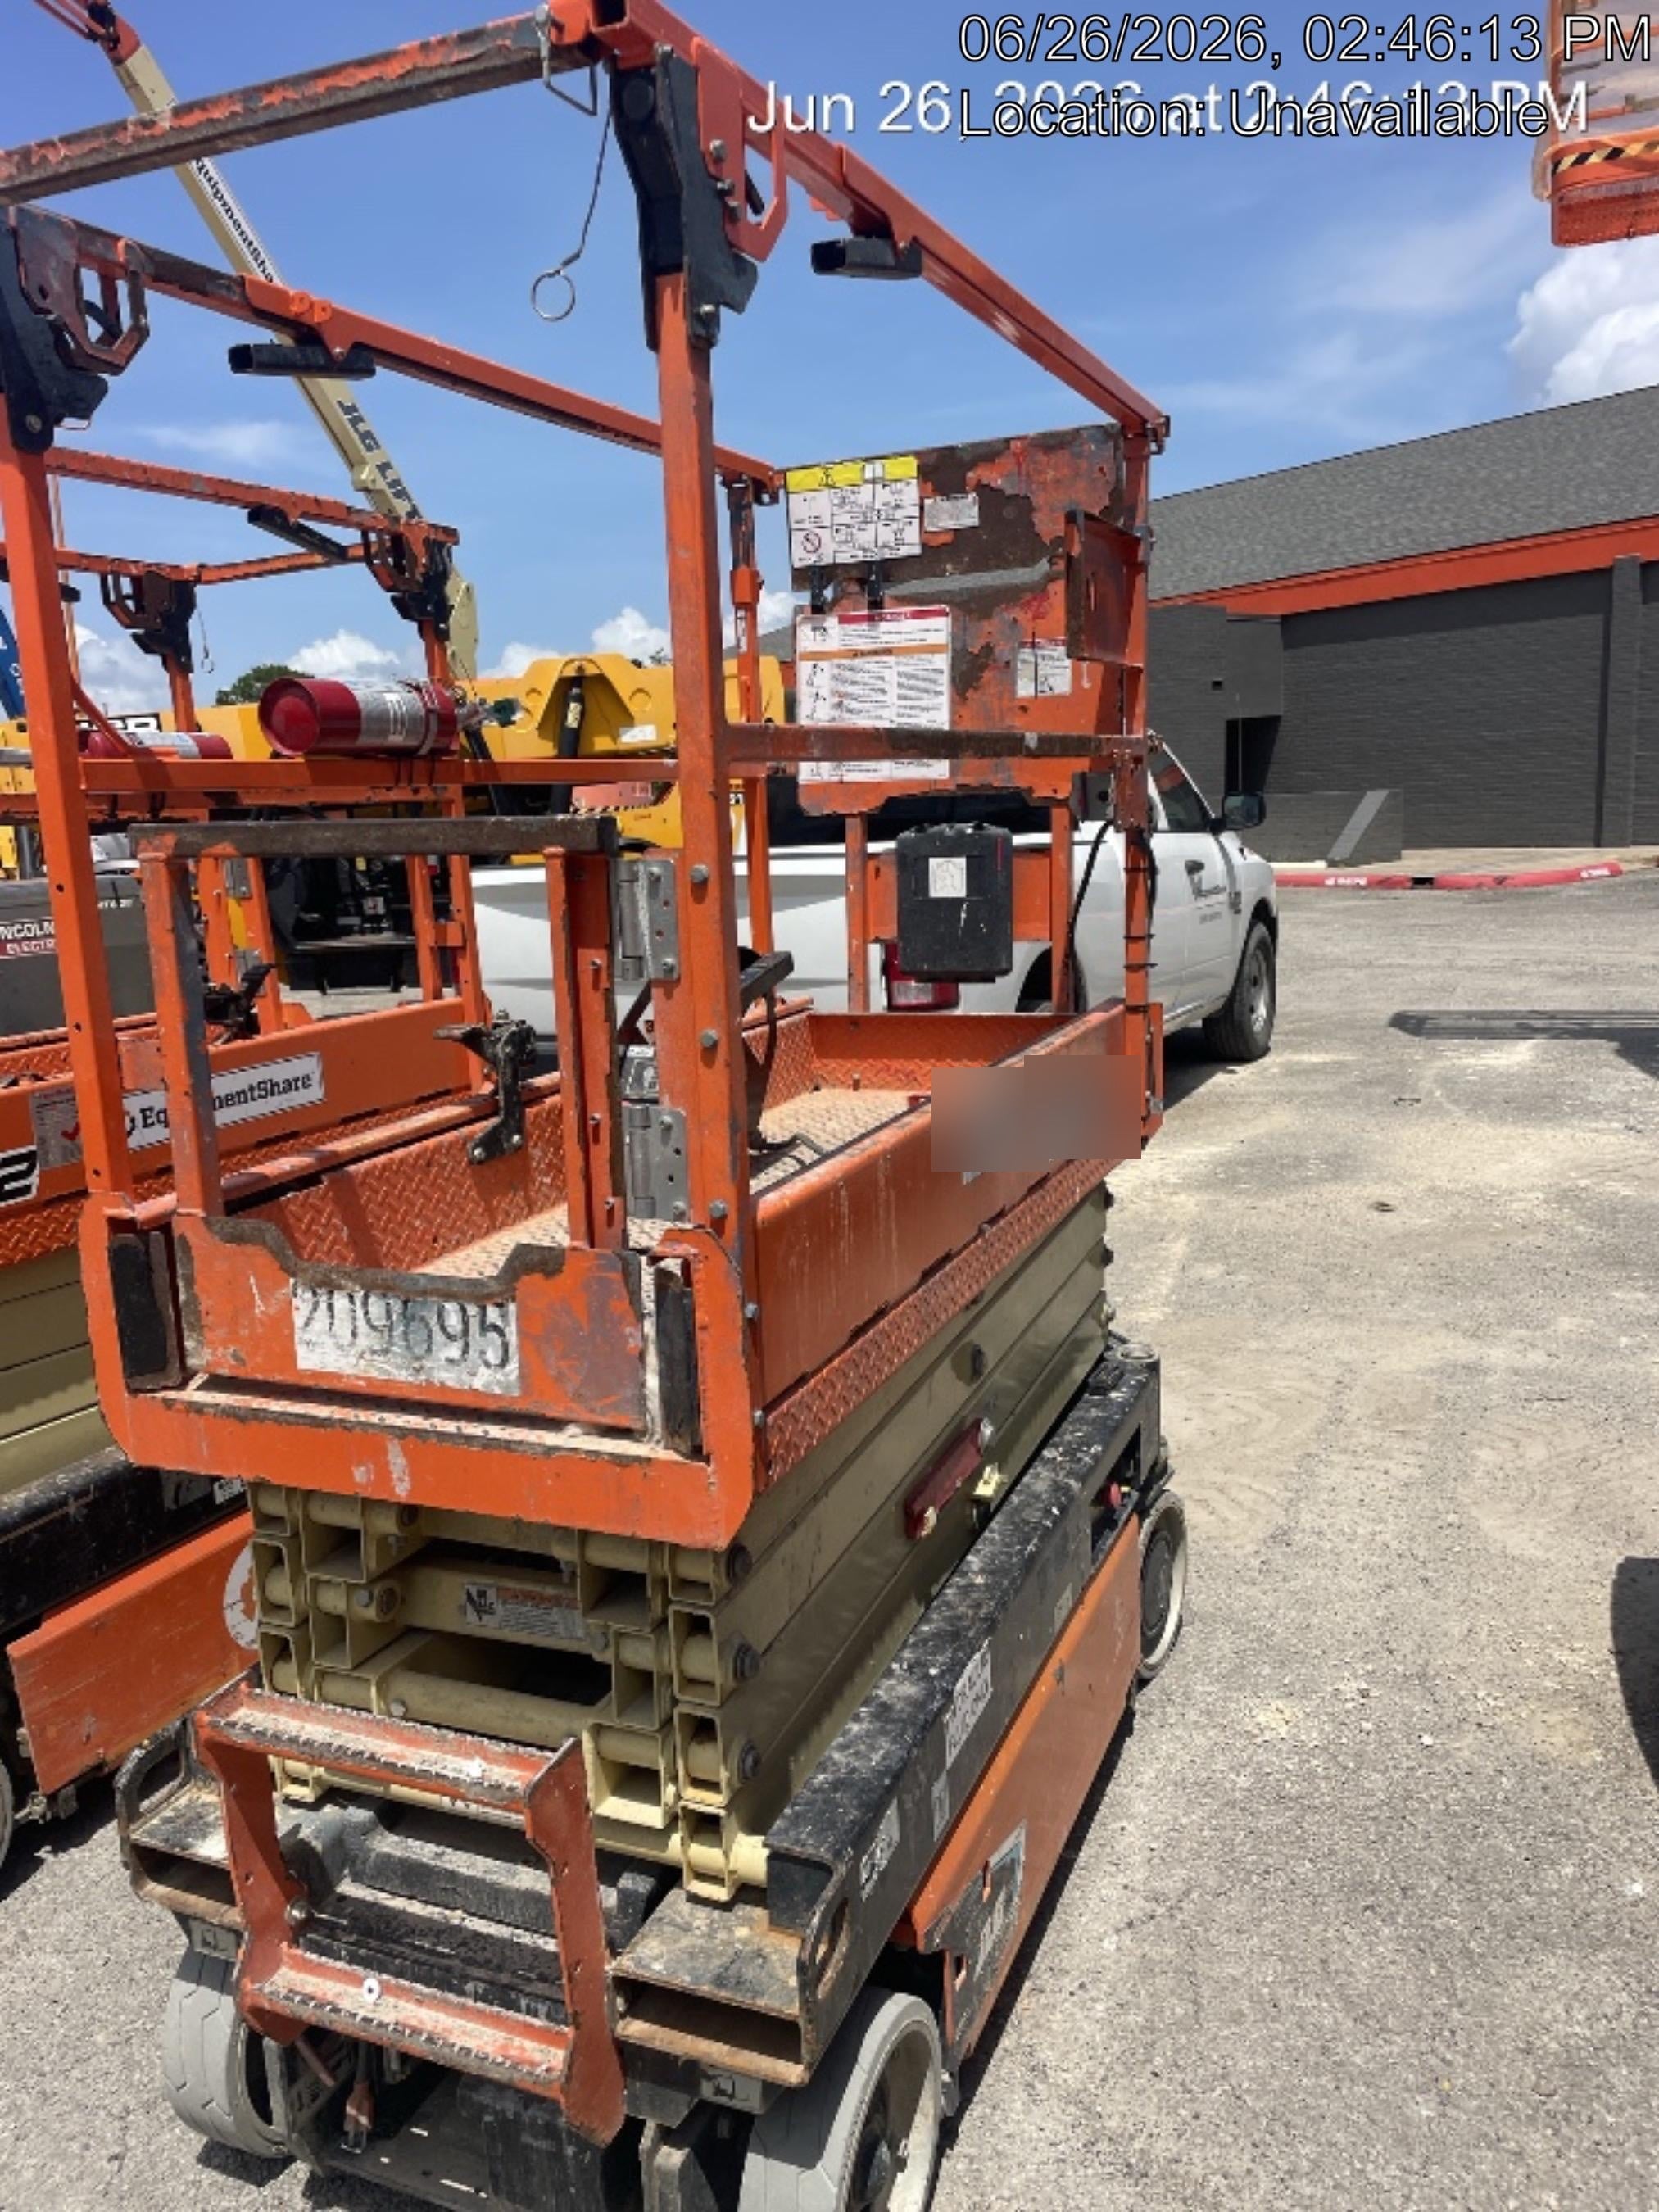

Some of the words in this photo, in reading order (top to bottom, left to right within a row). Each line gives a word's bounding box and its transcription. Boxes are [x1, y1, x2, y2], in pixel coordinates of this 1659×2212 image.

[336, 399, 382, 453] JLG
[0, 921, 56, 940] NCOLN
[6, 939, 57, 954] ELECTR
